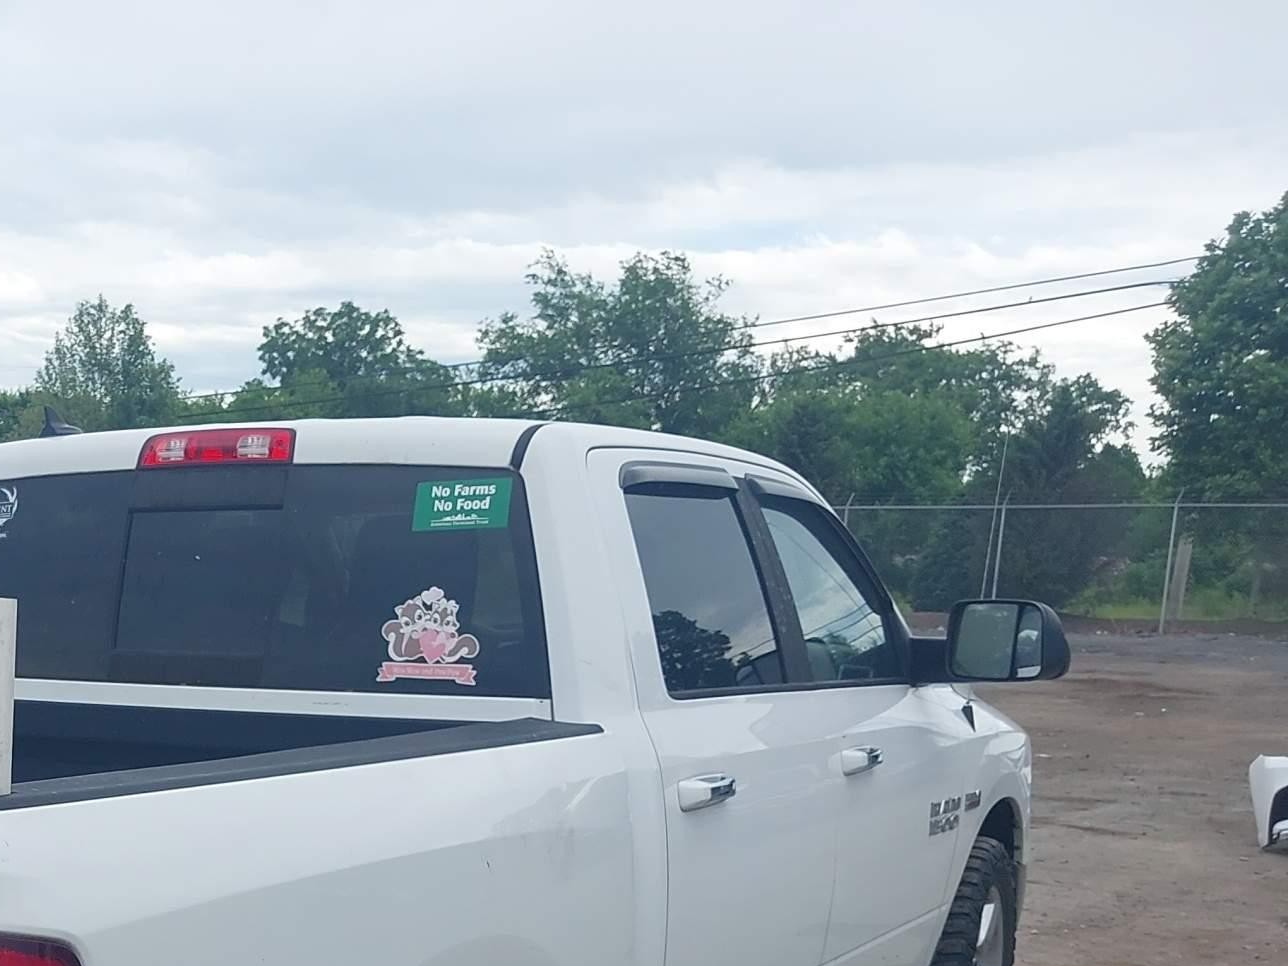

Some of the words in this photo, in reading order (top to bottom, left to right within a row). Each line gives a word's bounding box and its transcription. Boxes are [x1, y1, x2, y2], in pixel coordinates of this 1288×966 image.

[431, 485, 451, 498] No
[454, 483, 497, 497] Farms
[434, 499, 453, 512] No
[456, 496, 491, 511] Food
